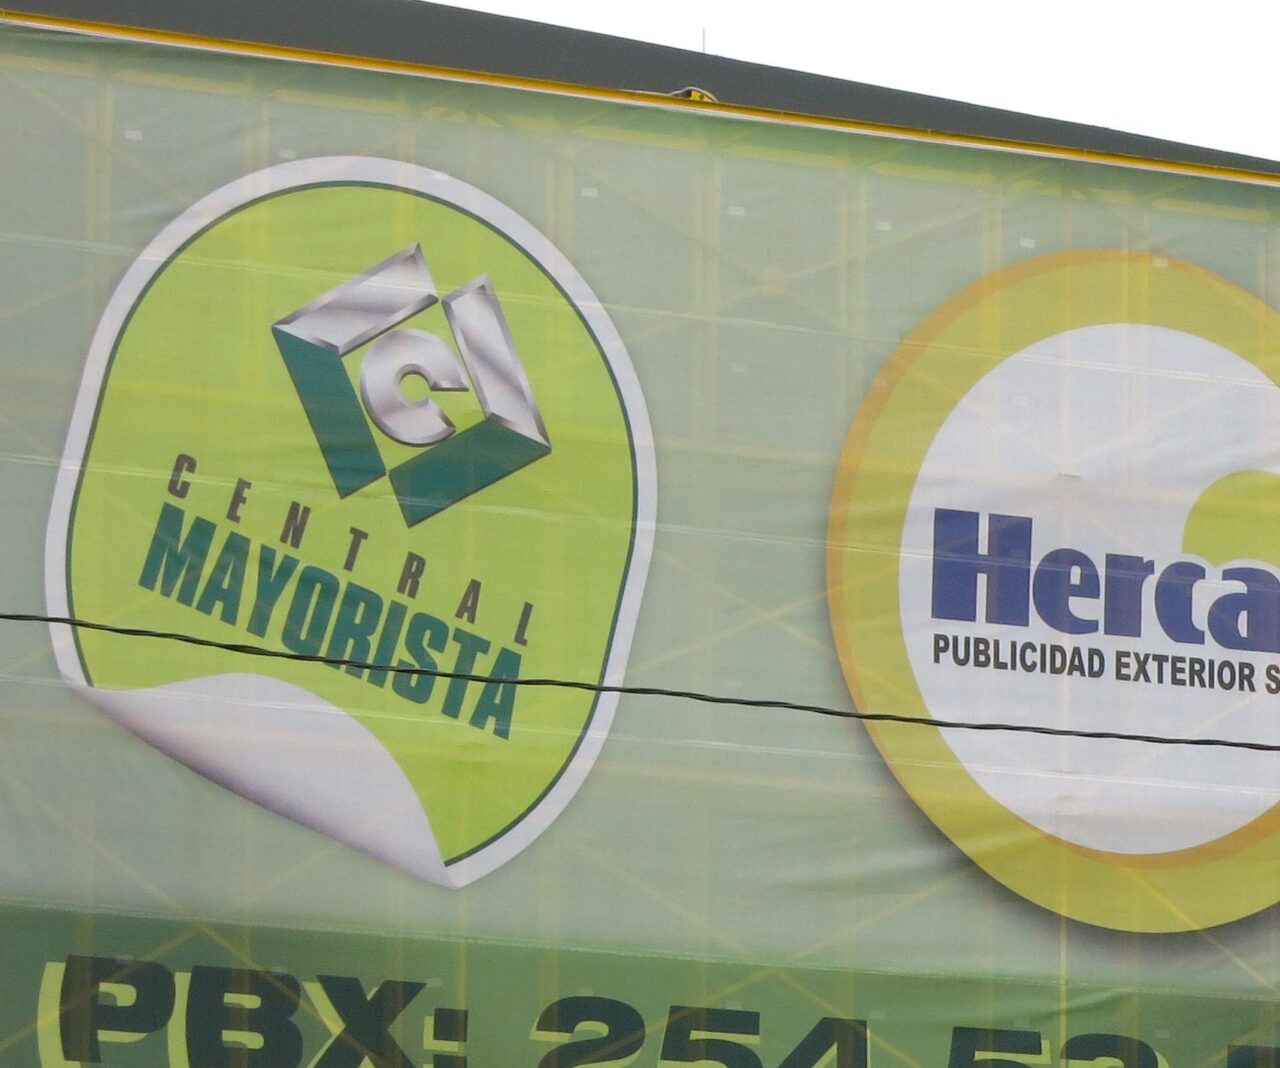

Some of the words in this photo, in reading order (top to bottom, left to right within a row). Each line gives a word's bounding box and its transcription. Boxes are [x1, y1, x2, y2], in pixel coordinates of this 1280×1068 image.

[138, 502, 522, 740] MAYORISTA
[168, 454, 534, 645] CENTRAL
[932, 634, 1105, 680] PUBLICIDAD
[1114, 650, 1256, 693] EXTERIOR
